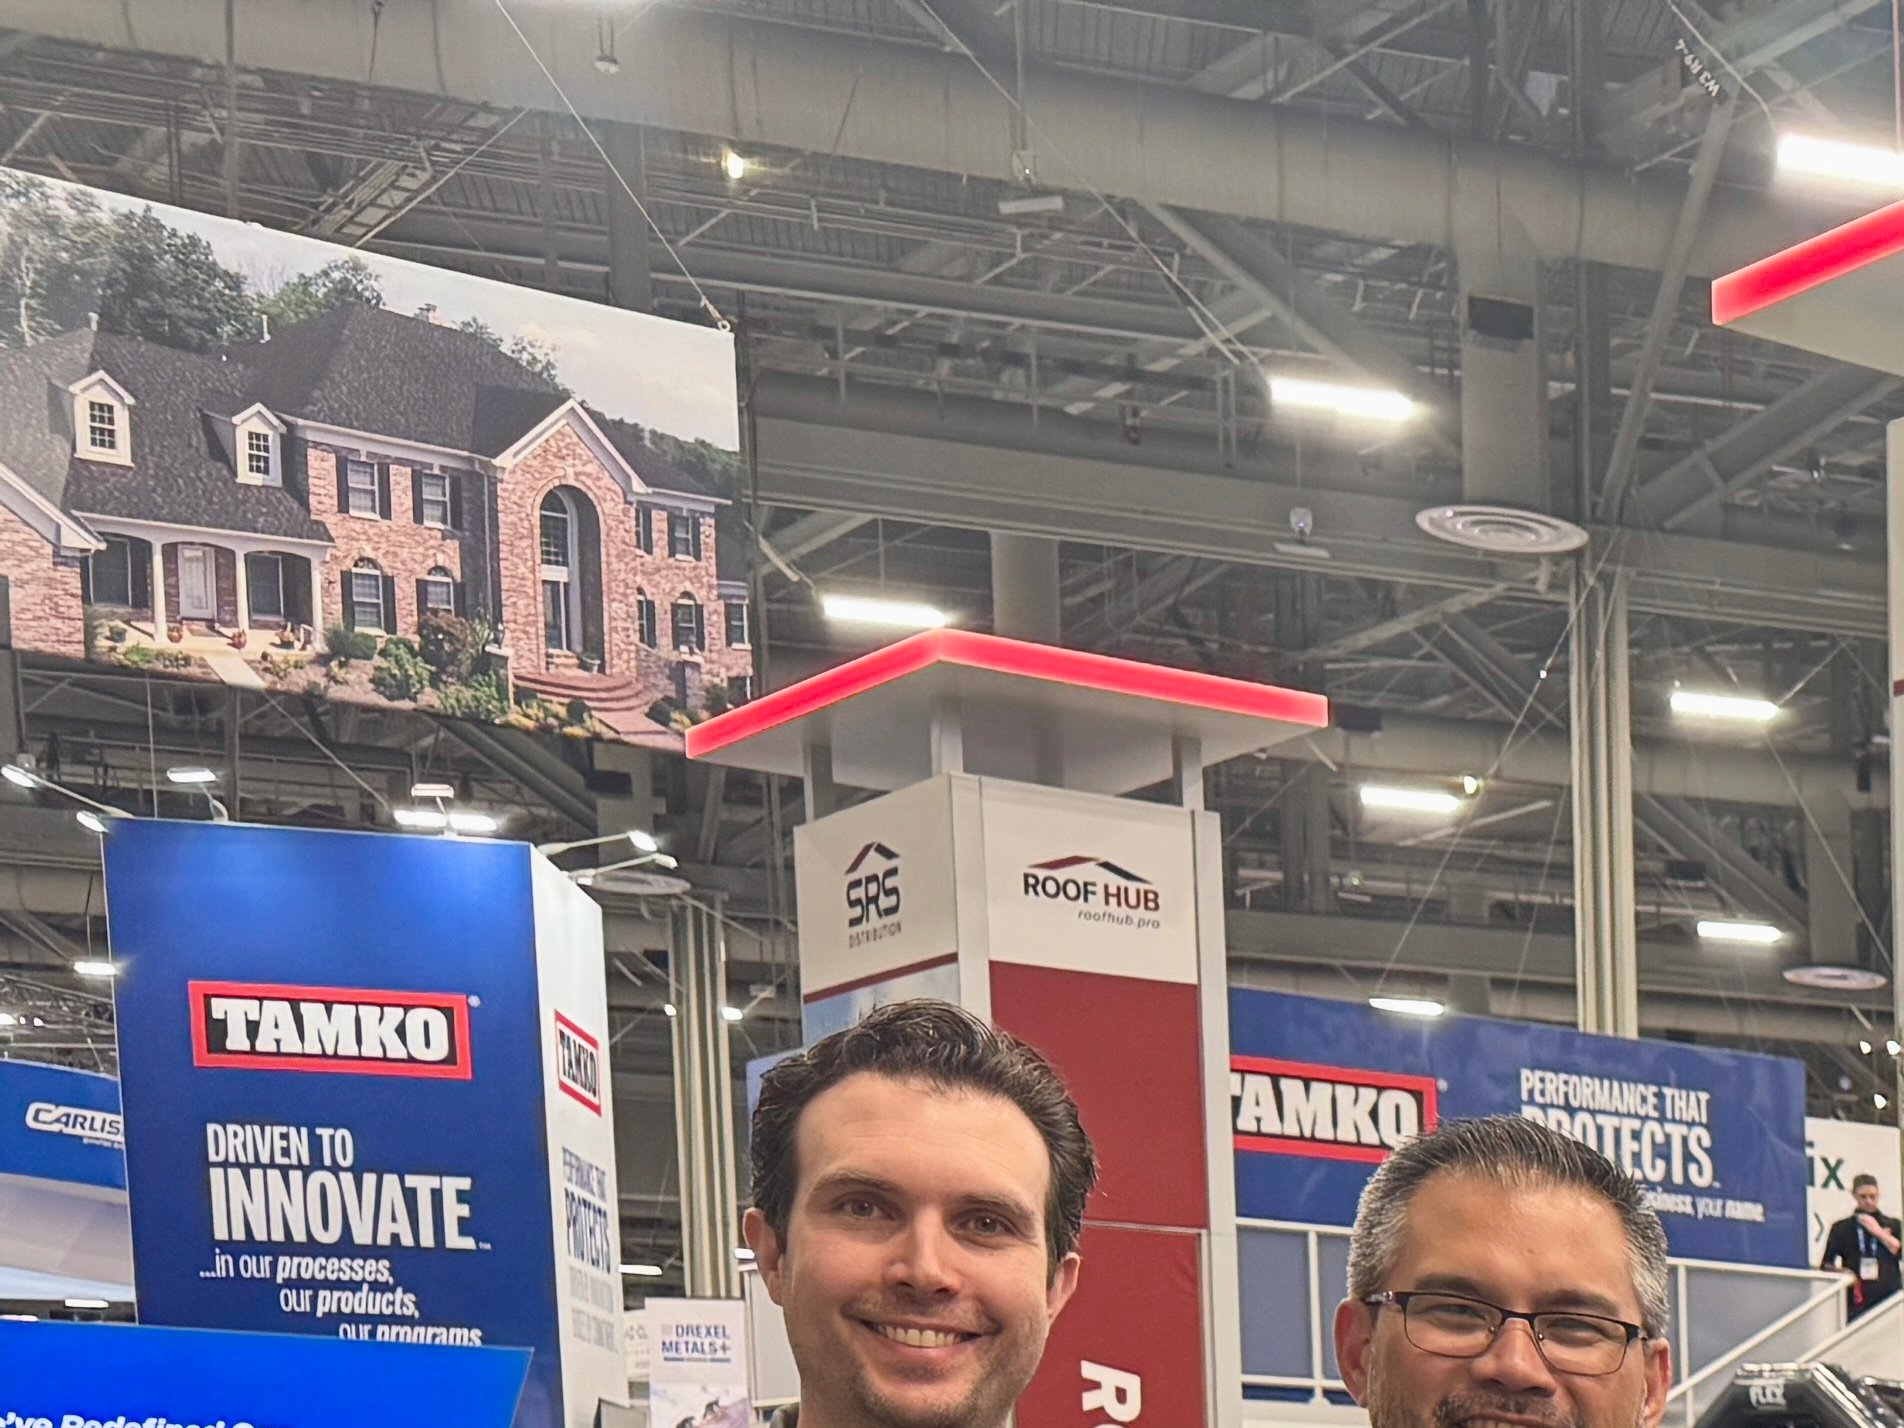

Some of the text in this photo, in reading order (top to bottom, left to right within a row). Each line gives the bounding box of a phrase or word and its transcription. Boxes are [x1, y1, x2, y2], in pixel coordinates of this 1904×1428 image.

[846, 867, 900, 927] SRS
[1023, 873, 1160, 913] ROOF HUB
[848, 923, 902, 948] DISTRIBUTION
[1078, 908, 1160, 929] roofhub.pro
[211, 996, 450, 1062] TAMKO
[1521, 1068, 1709, 1124] PERFORMANCE THAT
[207, 1123, 353, 1168] DRIVEN TO
[210, 1169, 477, 1250] INNOVATE
[239, 1255, 274, 1278] our
[277, 1256, 393, 1286] processes,
[280, 1287, 419, 1320] our products,
[676, 1324, 730, 1338] DREXEL
